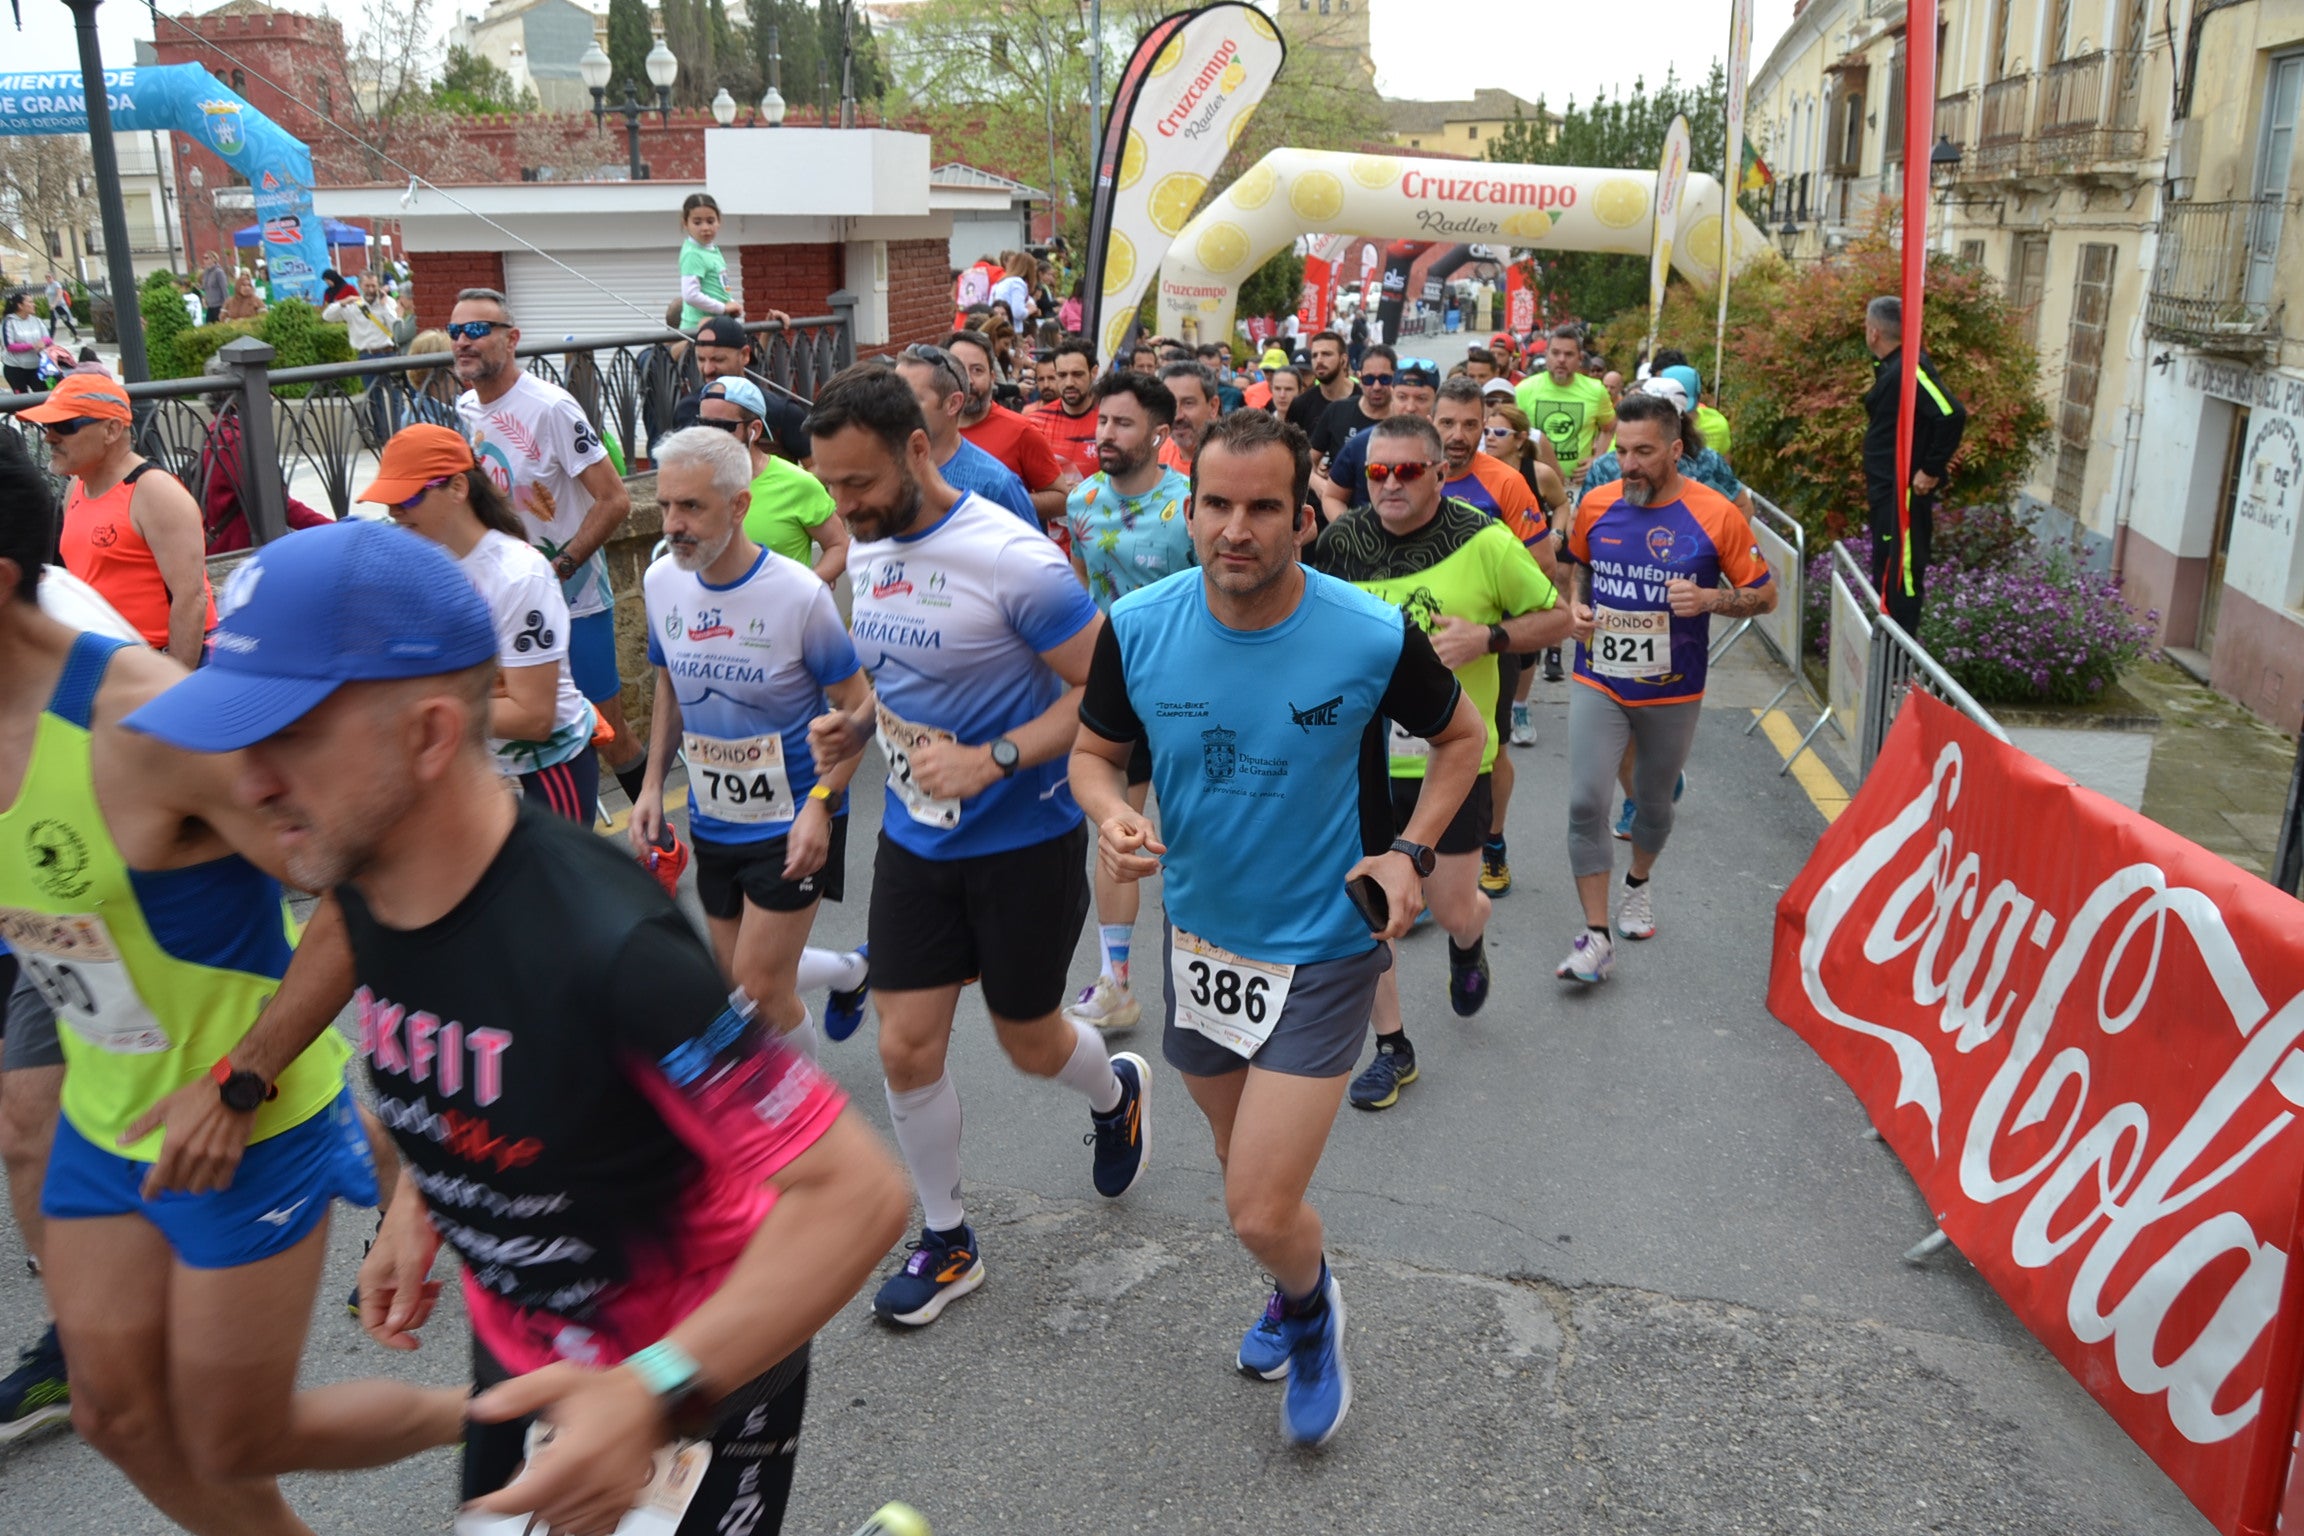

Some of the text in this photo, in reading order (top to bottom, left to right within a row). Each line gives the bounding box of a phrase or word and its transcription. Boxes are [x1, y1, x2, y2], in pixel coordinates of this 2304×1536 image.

[1157, 38, 1238, 137] Cruzcampo
[22, 93, 136, 114] GRANDA
[32, 116, 88, 127] DEPORT
[1184, 94, 1227, 141] Radler
[1402, 169, 1577, 211] Cruzcampo
[1416, 209, 1500, 235] Radler
[1163, 281, 1227, 298] Cruzcampo
[2274, 467, 2289, 488] DE
[696, 607, 721, 632] 35
[1606, 615, 1653, 629] FONDO
[1602, 636, 1654, 662] 821
[671, 659, 766, 684] MARACENA
[702, 743, 761, 764] FONDO
[1239, 753, 1289, 767] Diputación
[1239, 764, 1289, 777] de Granada
[702, 769, 774, 805] 794
[1213, 787, 1247, 798] provincia
[1249, 790, 1257, 798] se
[1259, 789, 1287, 800] mueve
[1188, 959, 1270, 1024] 386
